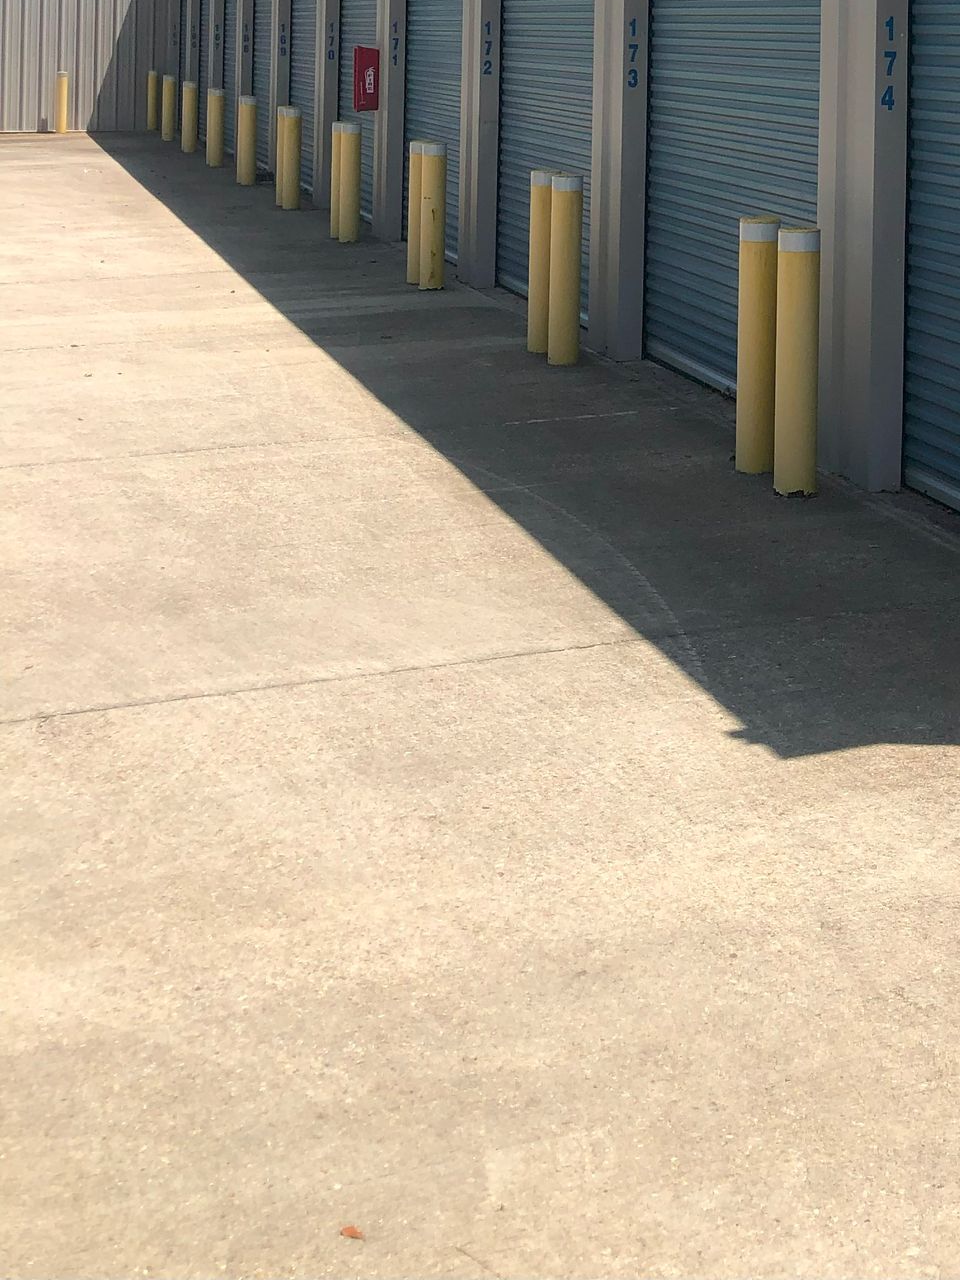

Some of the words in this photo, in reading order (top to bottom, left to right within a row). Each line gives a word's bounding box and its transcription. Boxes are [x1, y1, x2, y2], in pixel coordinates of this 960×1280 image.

[392, 21, 400, 66] 171
[483, 20, 493, 75] 172
[627, 17, 639, 88] 173
[880, 16, 897, 111] 174
